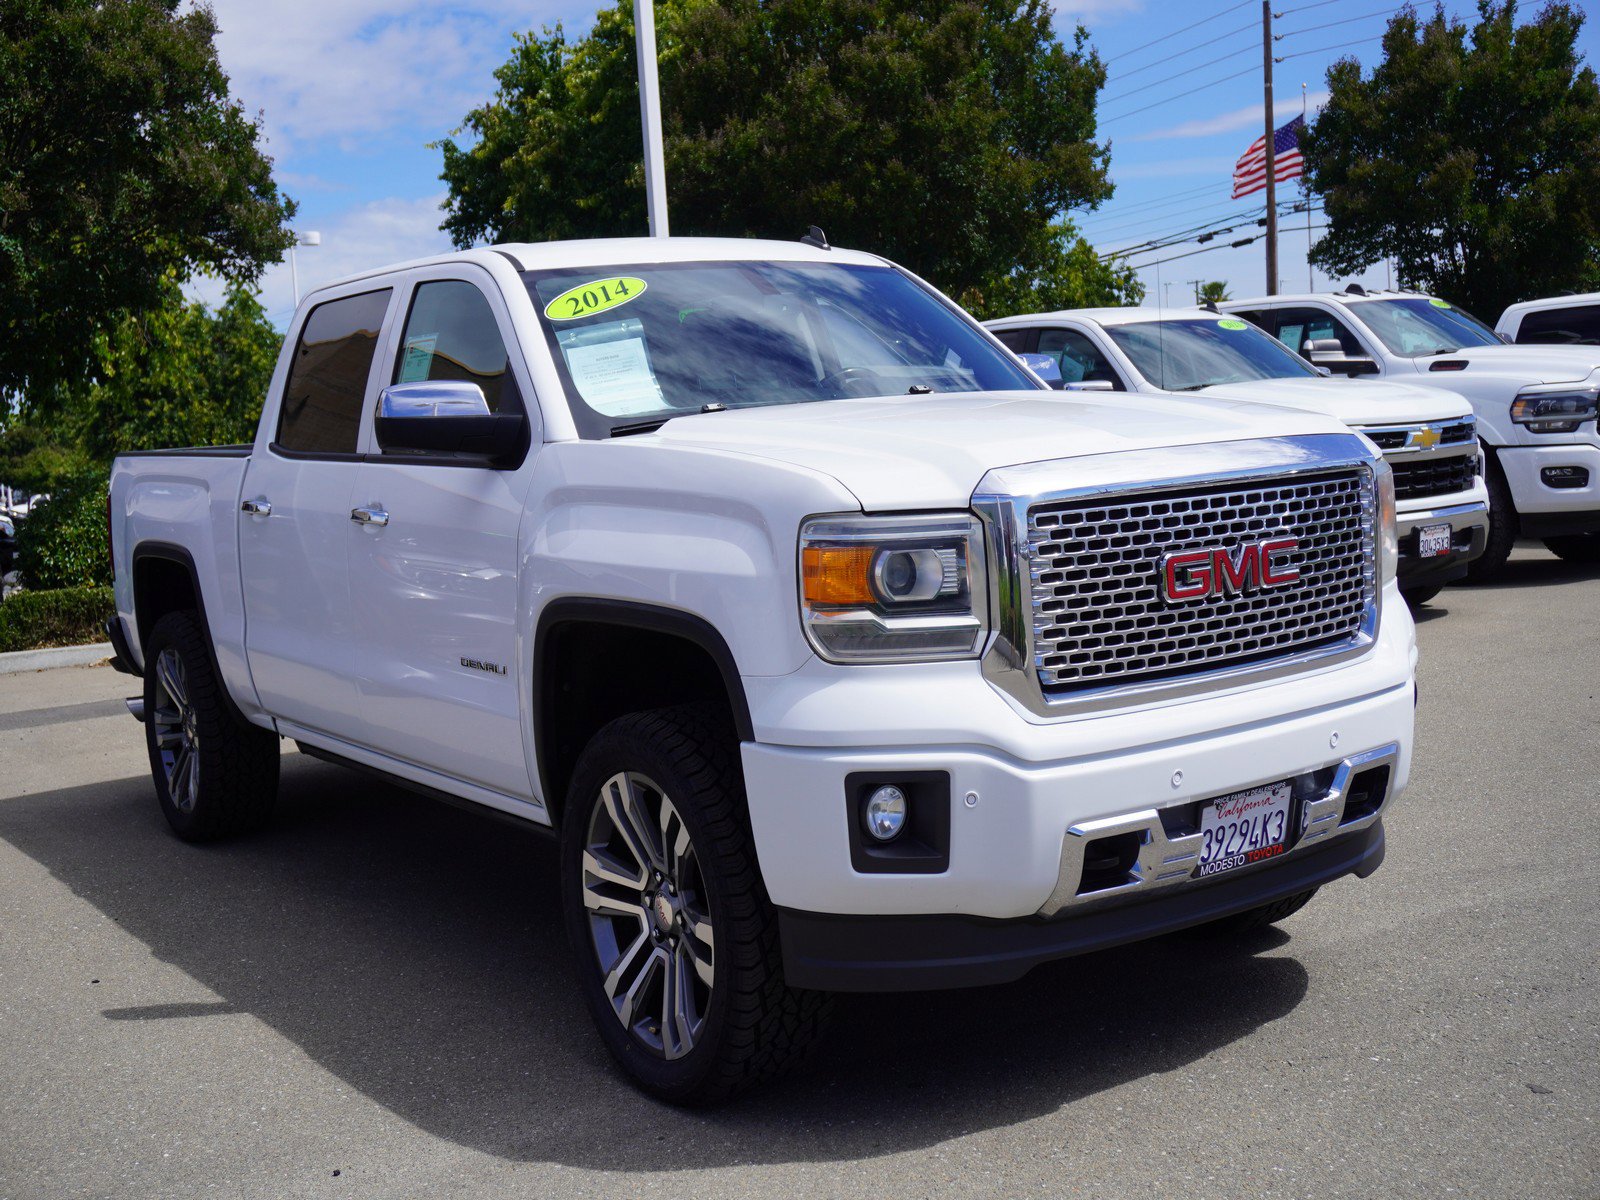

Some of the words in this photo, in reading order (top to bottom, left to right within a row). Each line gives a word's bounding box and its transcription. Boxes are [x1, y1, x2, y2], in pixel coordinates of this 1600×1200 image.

[566, 280, 630, 316] 2014
[1160, 536, 1300, 603] GMC
[460, 656, 507, 675] DENALI
[1213, 795, 1231, 805] PRICE
[1231, 791, 1250, 801] FAMILY
[1251, 782, 1286, 797] DEALERSHIPS
[1217, 796, 1275, 819] California
[1200, 809, 1285, 863] 39294K3
[1200, 854, 1246, 876] MODESTO
[1247, 844, 1284, 863] TOYOTA
